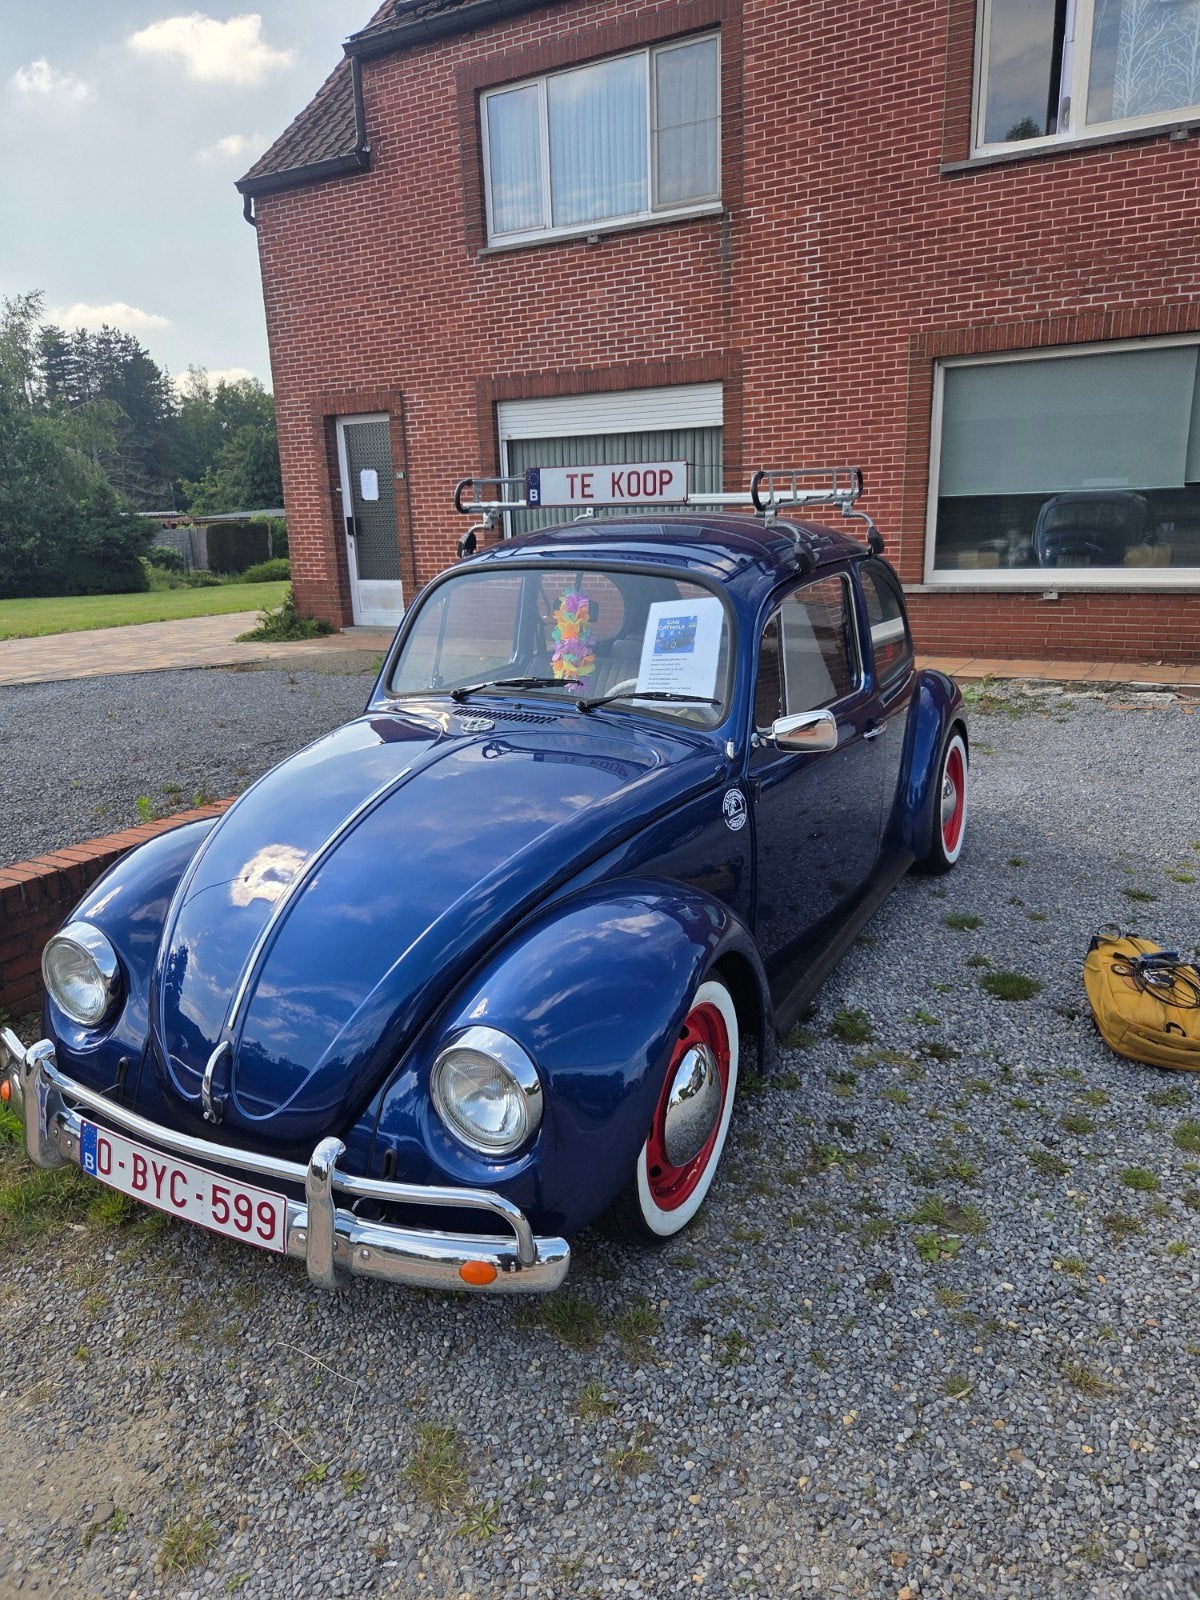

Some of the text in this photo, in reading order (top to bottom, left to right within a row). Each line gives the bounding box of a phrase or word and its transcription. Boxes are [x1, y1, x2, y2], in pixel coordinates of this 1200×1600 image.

[529, 489, 539, 502] B
[566, 469, 673, 499] TE KOOP
[84, 1152, 95, 1171] B
[97, 1137, 276, 1241] O-BYC-599
